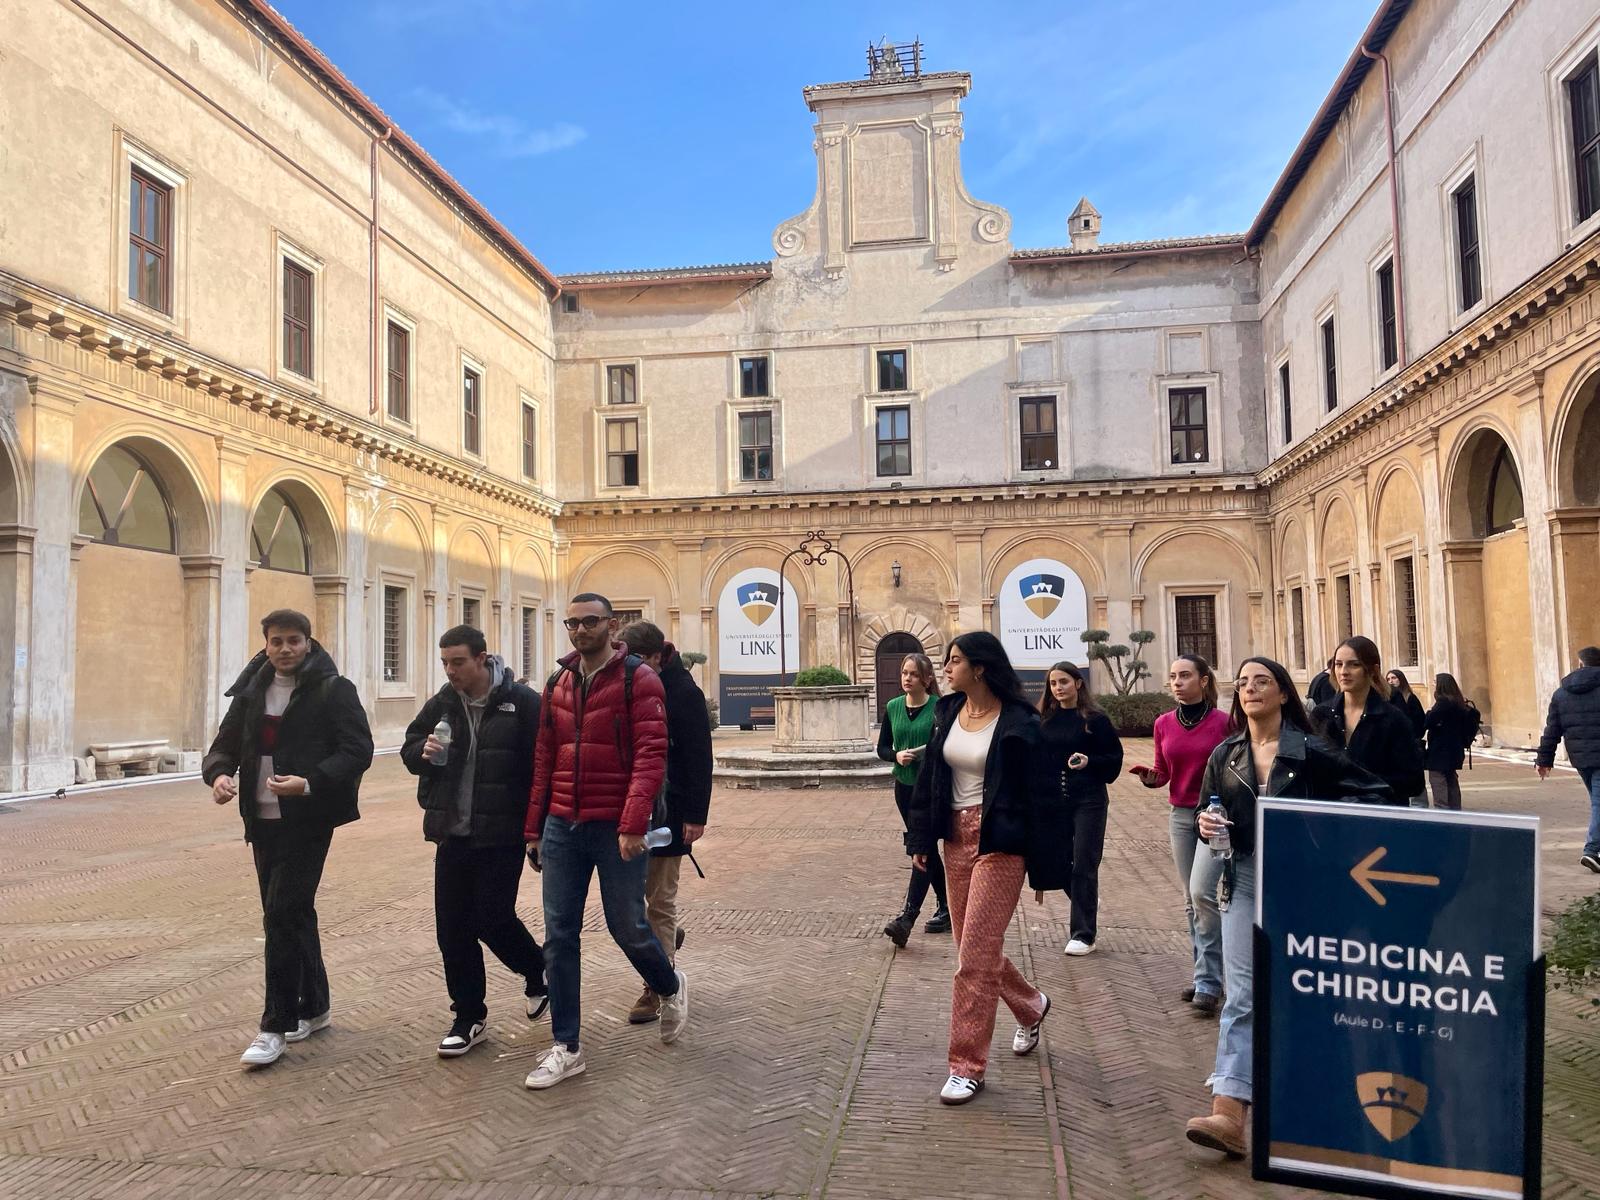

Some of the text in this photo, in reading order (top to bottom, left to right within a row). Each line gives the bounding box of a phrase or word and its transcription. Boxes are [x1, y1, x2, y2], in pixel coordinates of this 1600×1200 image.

[741, 641, 776, 655] LINK
[1024, 635, 1063, 649] LINK
[1286, 933, 1505, 980] MEDICINA E
[1291, 969, 1498, 1016] CHIRURGIA
[1333, 1012, 1369, 1027] (Aule
[1372, 1017, 1384, 1029] D
[1396, 1021, 1405, 1033] E
[1417, 1024, 1426, 1036] F
[1438, 1027, 1454, 1040] G)
